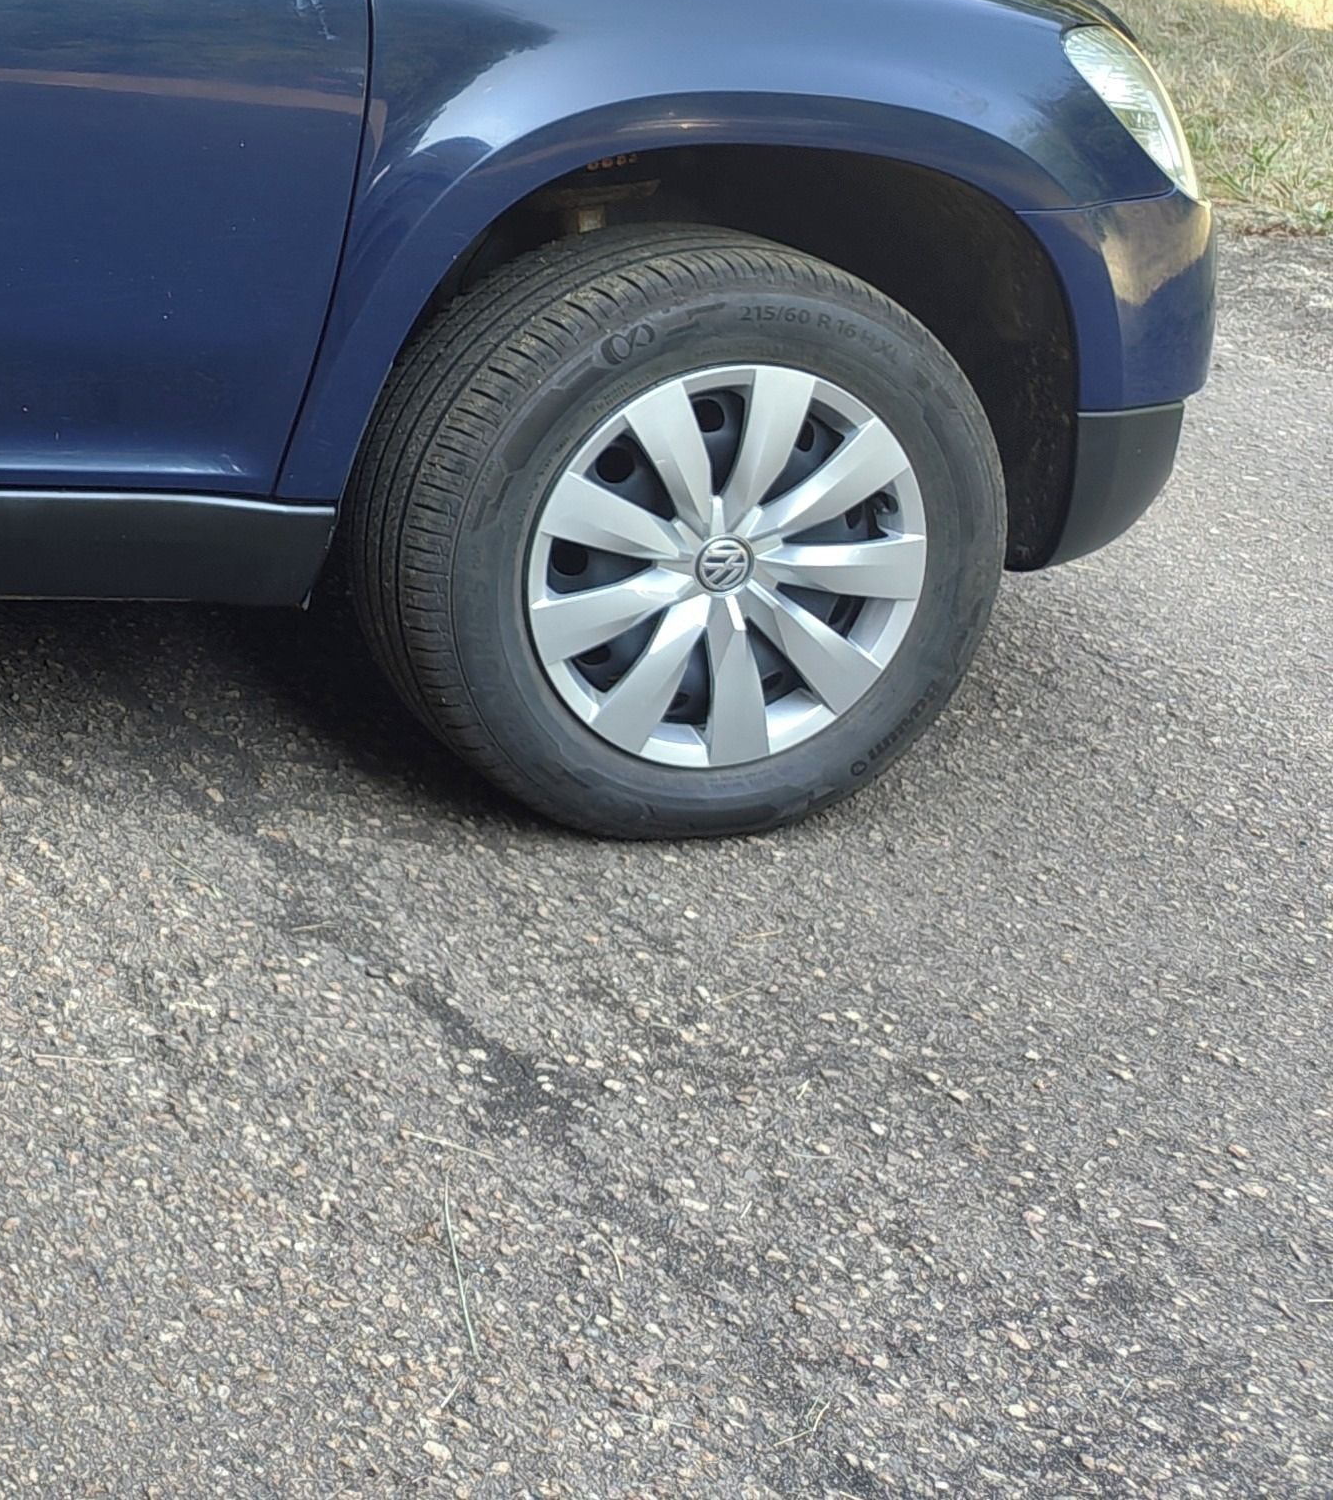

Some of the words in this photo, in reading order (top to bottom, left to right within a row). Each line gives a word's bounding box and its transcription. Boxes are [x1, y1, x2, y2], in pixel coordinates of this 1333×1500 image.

[740, 306, 810, 324] 215/60
[817, 313, 831, 330] R
[836, 320, 856, 339] 16
